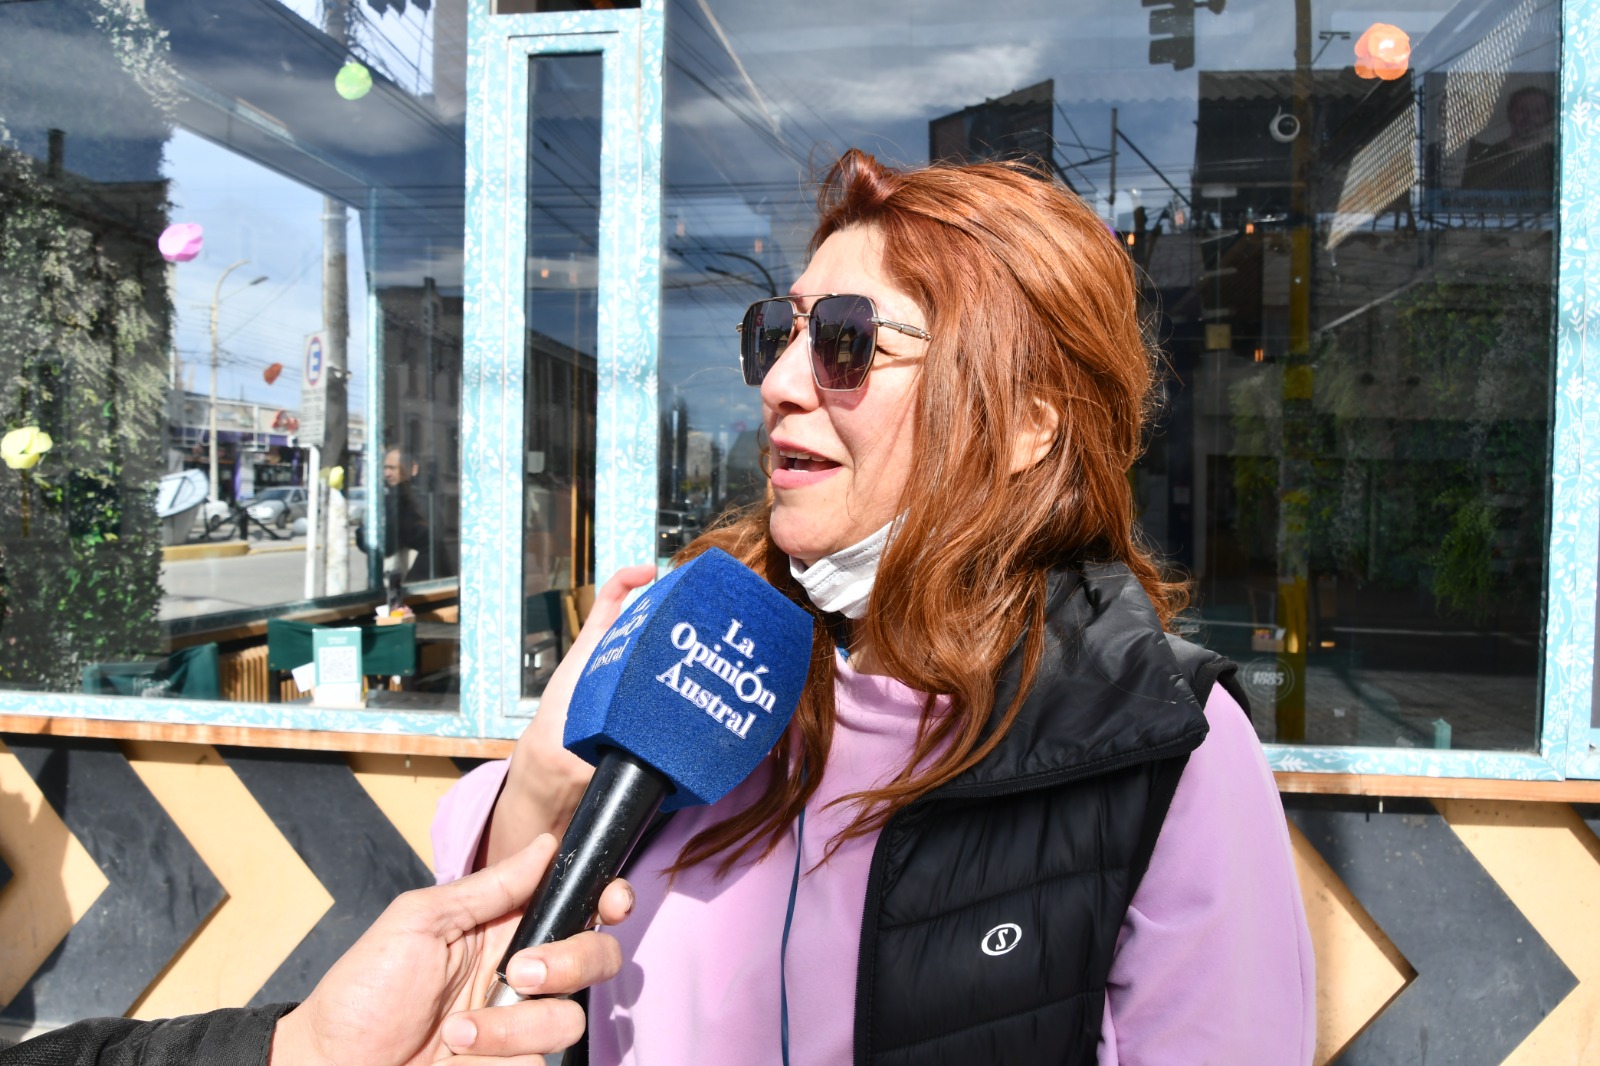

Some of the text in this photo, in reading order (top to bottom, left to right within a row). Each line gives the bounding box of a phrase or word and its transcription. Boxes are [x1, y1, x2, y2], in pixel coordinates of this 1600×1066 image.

[722, 618, 756, 659] La
[1252, 671, 1284, 686] 1885
[655, 661, 757, 739] Austral
